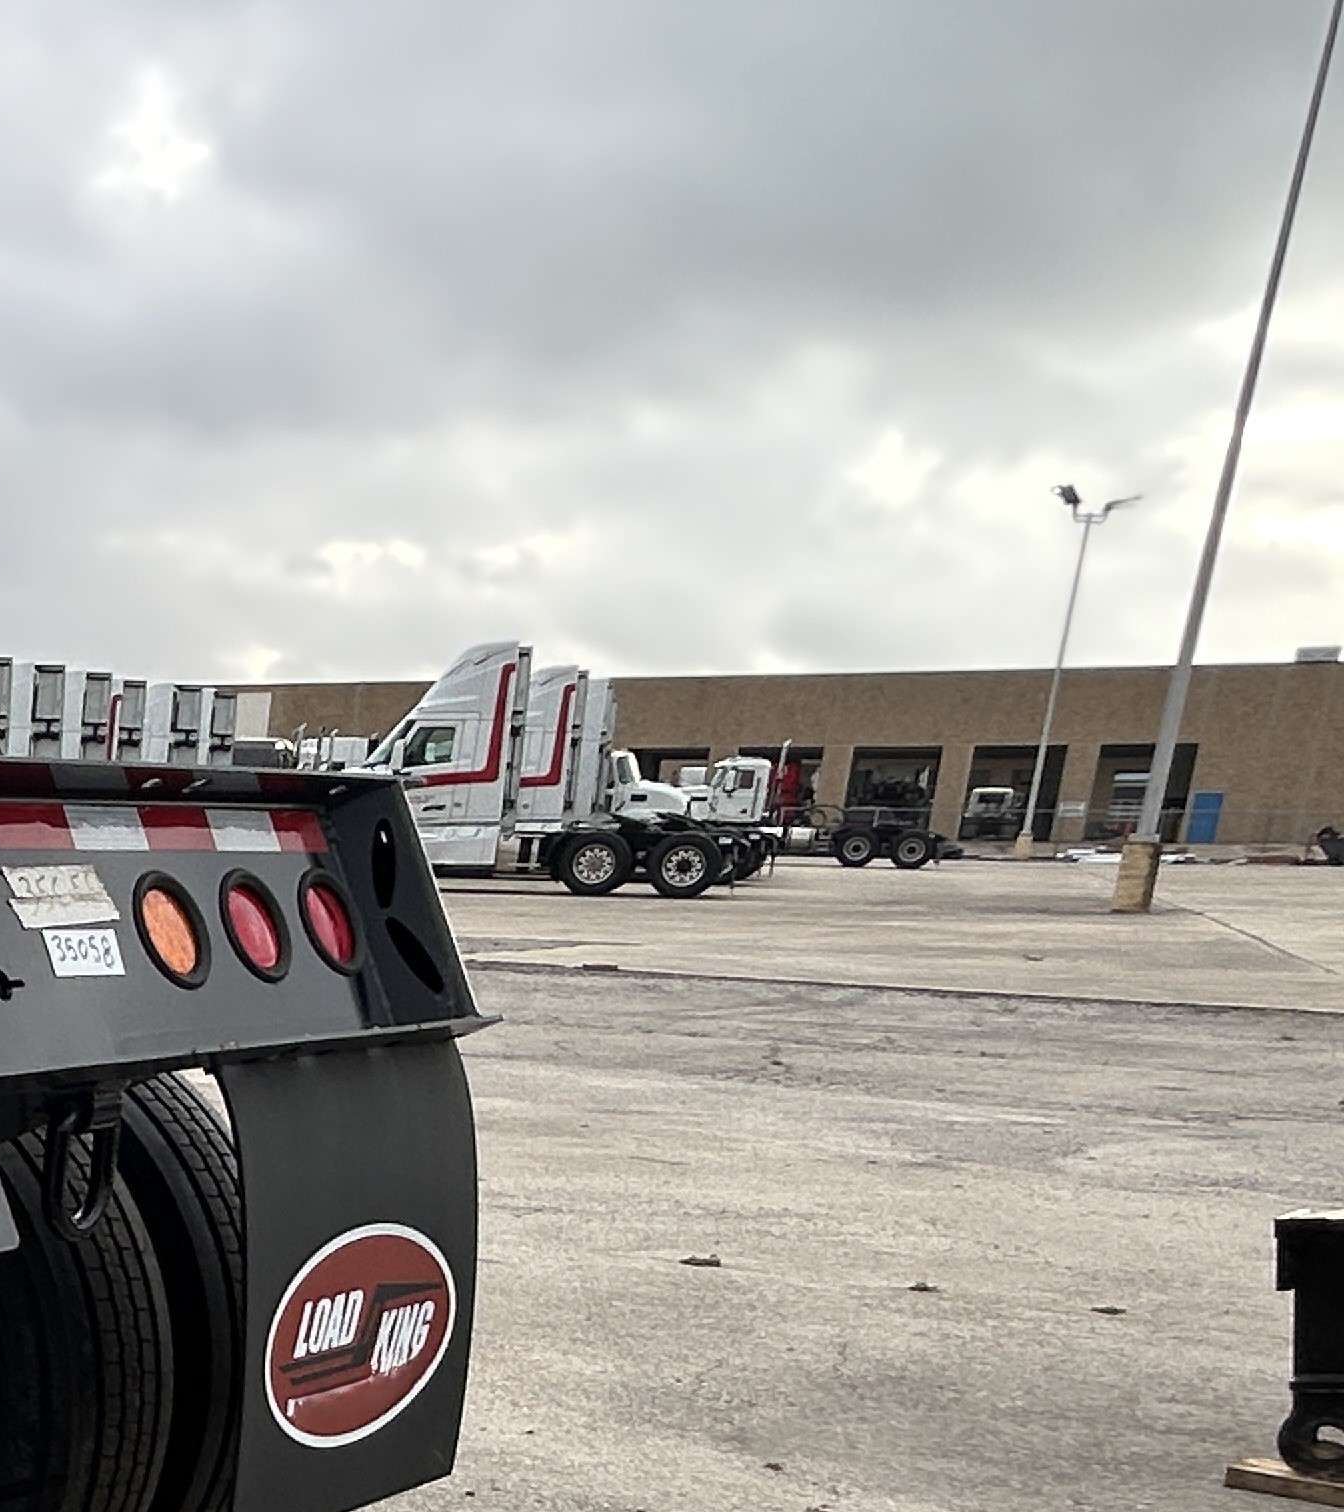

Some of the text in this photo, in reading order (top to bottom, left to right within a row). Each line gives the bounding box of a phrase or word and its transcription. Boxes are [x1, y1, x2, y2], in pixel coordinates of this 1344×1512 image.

[50, 934, 116, 969] 35058
[292, 1288, 436, 1376] LOAD KING
